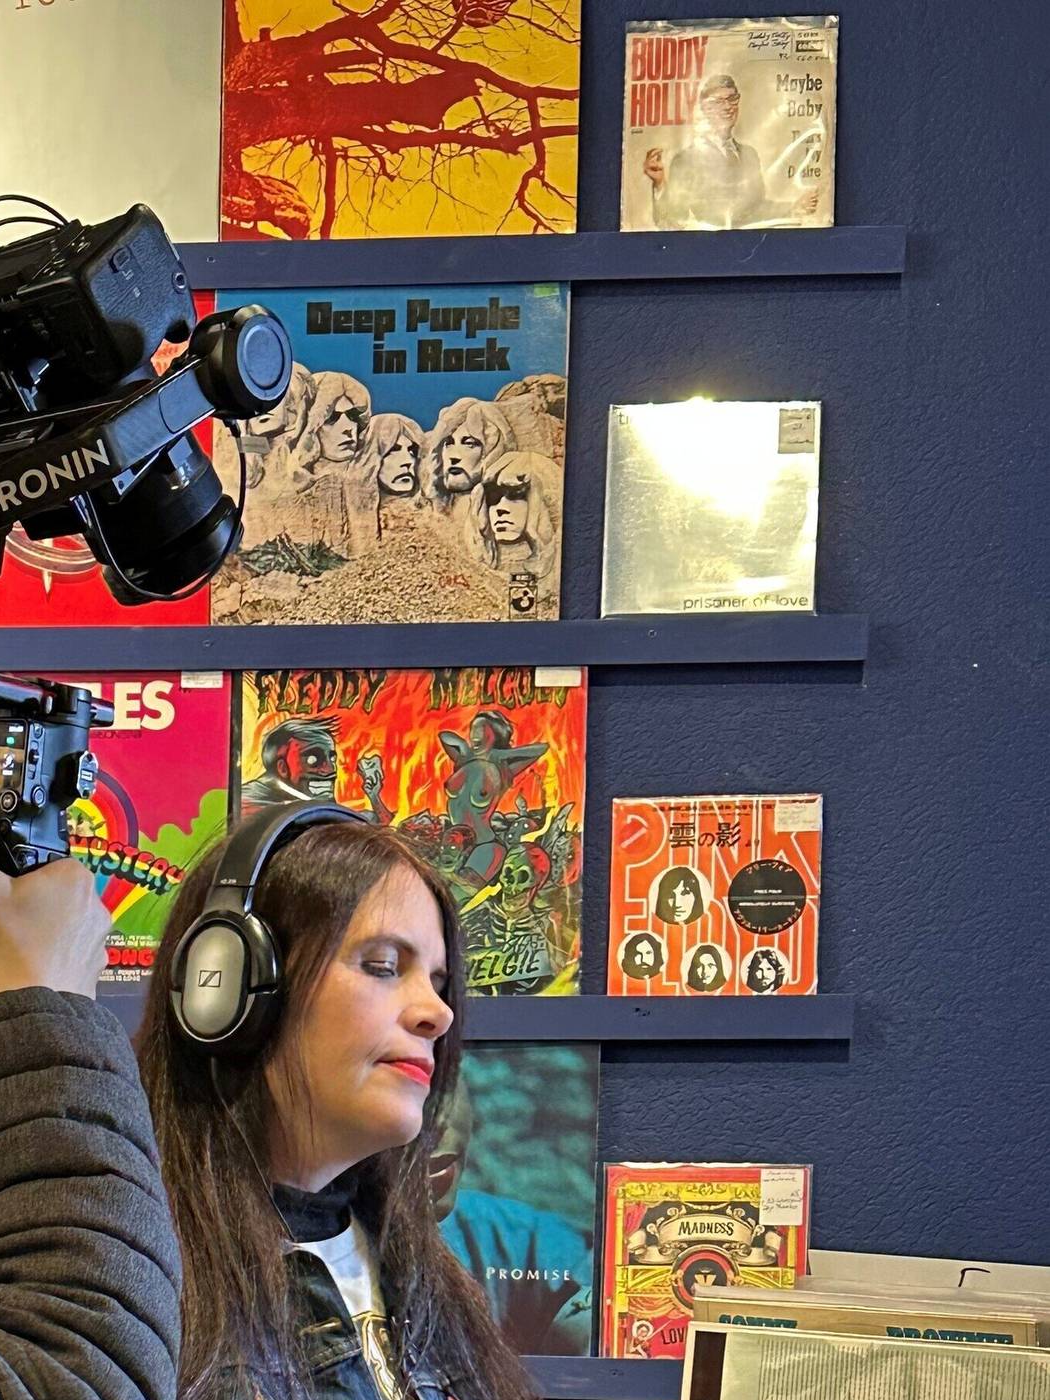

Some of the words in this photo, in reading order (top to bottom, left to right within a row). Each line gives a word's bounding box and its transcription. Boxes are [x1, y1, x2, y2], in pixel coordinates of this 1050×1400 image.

[632, 36, 709, 82] BUDDY
[776, 73, 823, 95] Maybe
[630, 82, 702, 128] HOLLY
[787, 99, 823, 119] Baby
[788, 165, 822, 179] Dsire
[307, 302, 396, 341] Deep
[406, 297, 521, 339] Purple
[373, 343, 406, 373] in
[417, 338, 510, 373] Rock
[683, 597, 746, 610] prisoner
[752, 596, 770, 607] of
[775, 595, 809, 607] love
[678, 1221, 735, 1237] MADNESS
[485, 1266, 571, 1281] PROMISE
[661, 1327, 686, 1345] LOV
